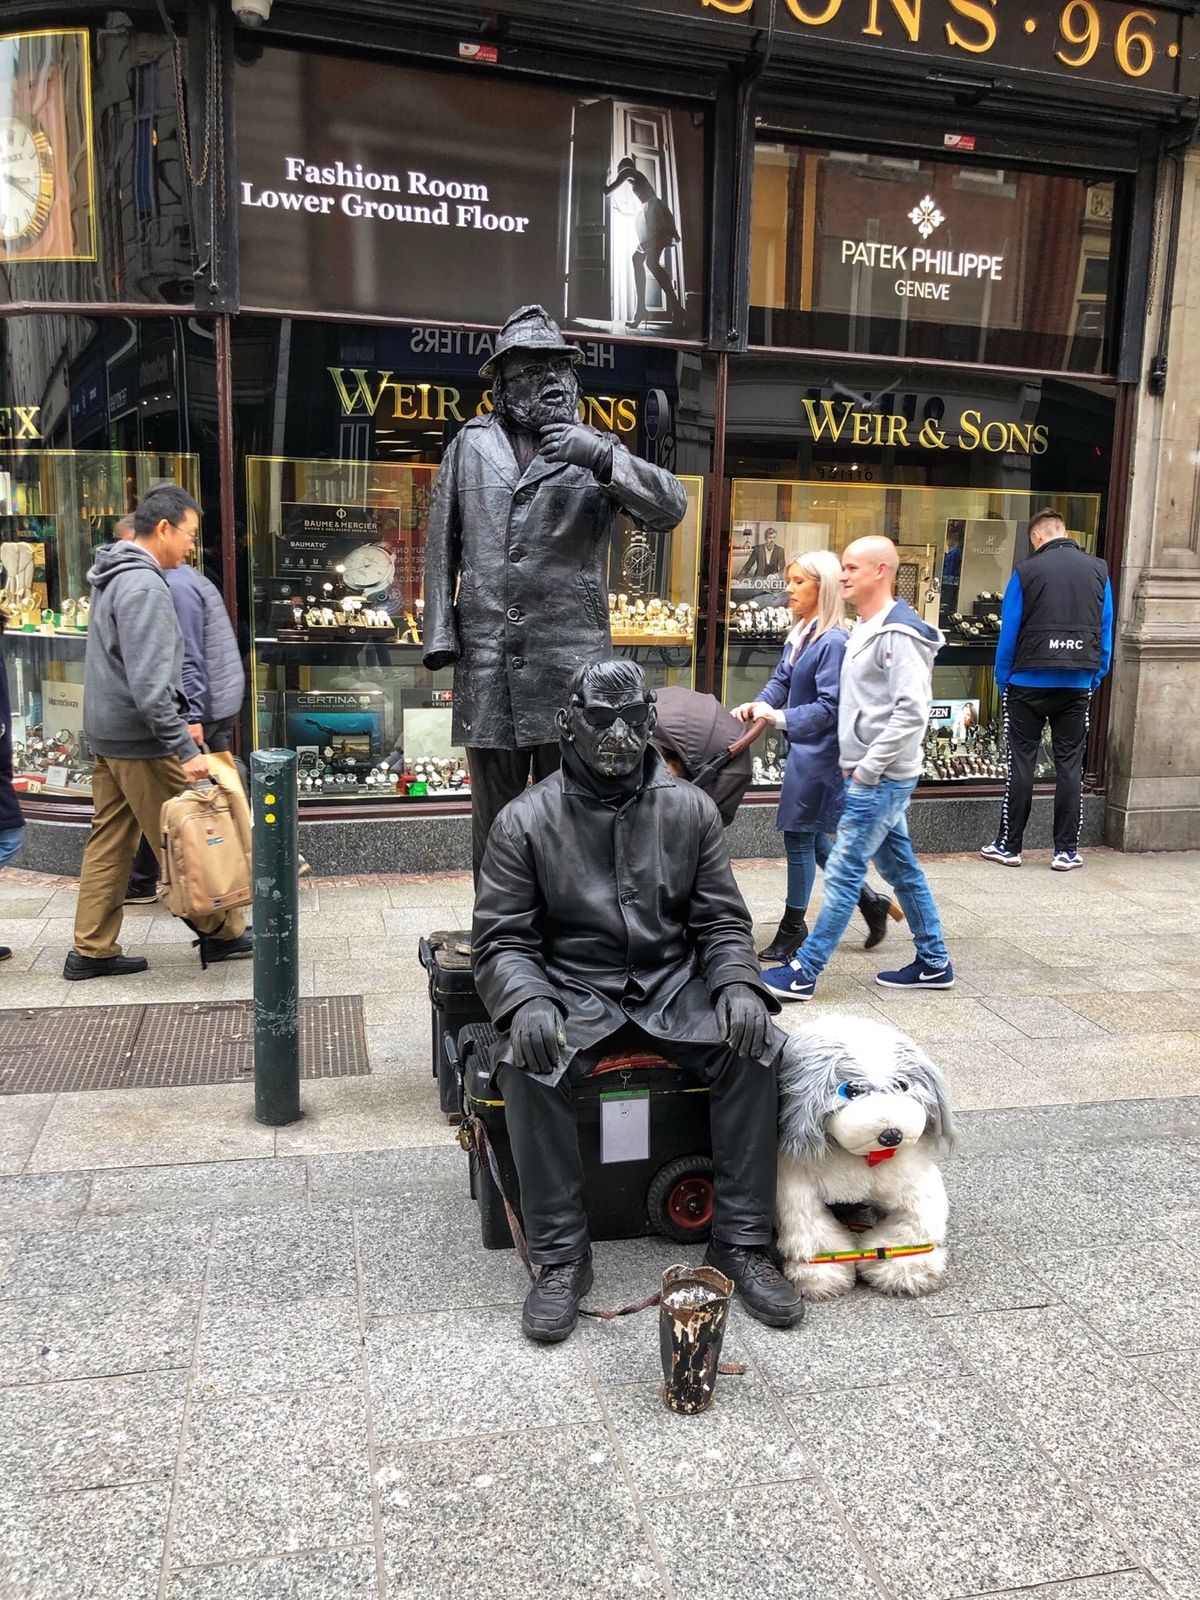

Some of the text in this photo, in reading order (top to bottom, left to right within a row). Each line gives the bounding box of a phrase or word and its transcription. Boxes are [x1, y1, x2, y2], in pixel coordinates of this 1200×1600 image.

[1055, 0, 1158, 77] 96
[286, 157, 489, 201] Fashion Room
[241, 182, 529, 233] Lower Ground Floor
[842, 240, 1004, 280] PATEK PHILIPPE
[895, 280, 950, 300] GENEVE
[327, 367, 466, 422] WEIR
[801, 399, 911, 447] WEIR
[918, 417, 950, 449] &
[958, 409, 1049, 454] SONS
[341, 522, 378, 530] MERCIER
[290, 541, 326, 549] BAUMATIC
[1050, 640, 1084, 650] M+RC
[297, 695, 358, 704] CERTINA
[930, 708, 949, 717] ZEN
